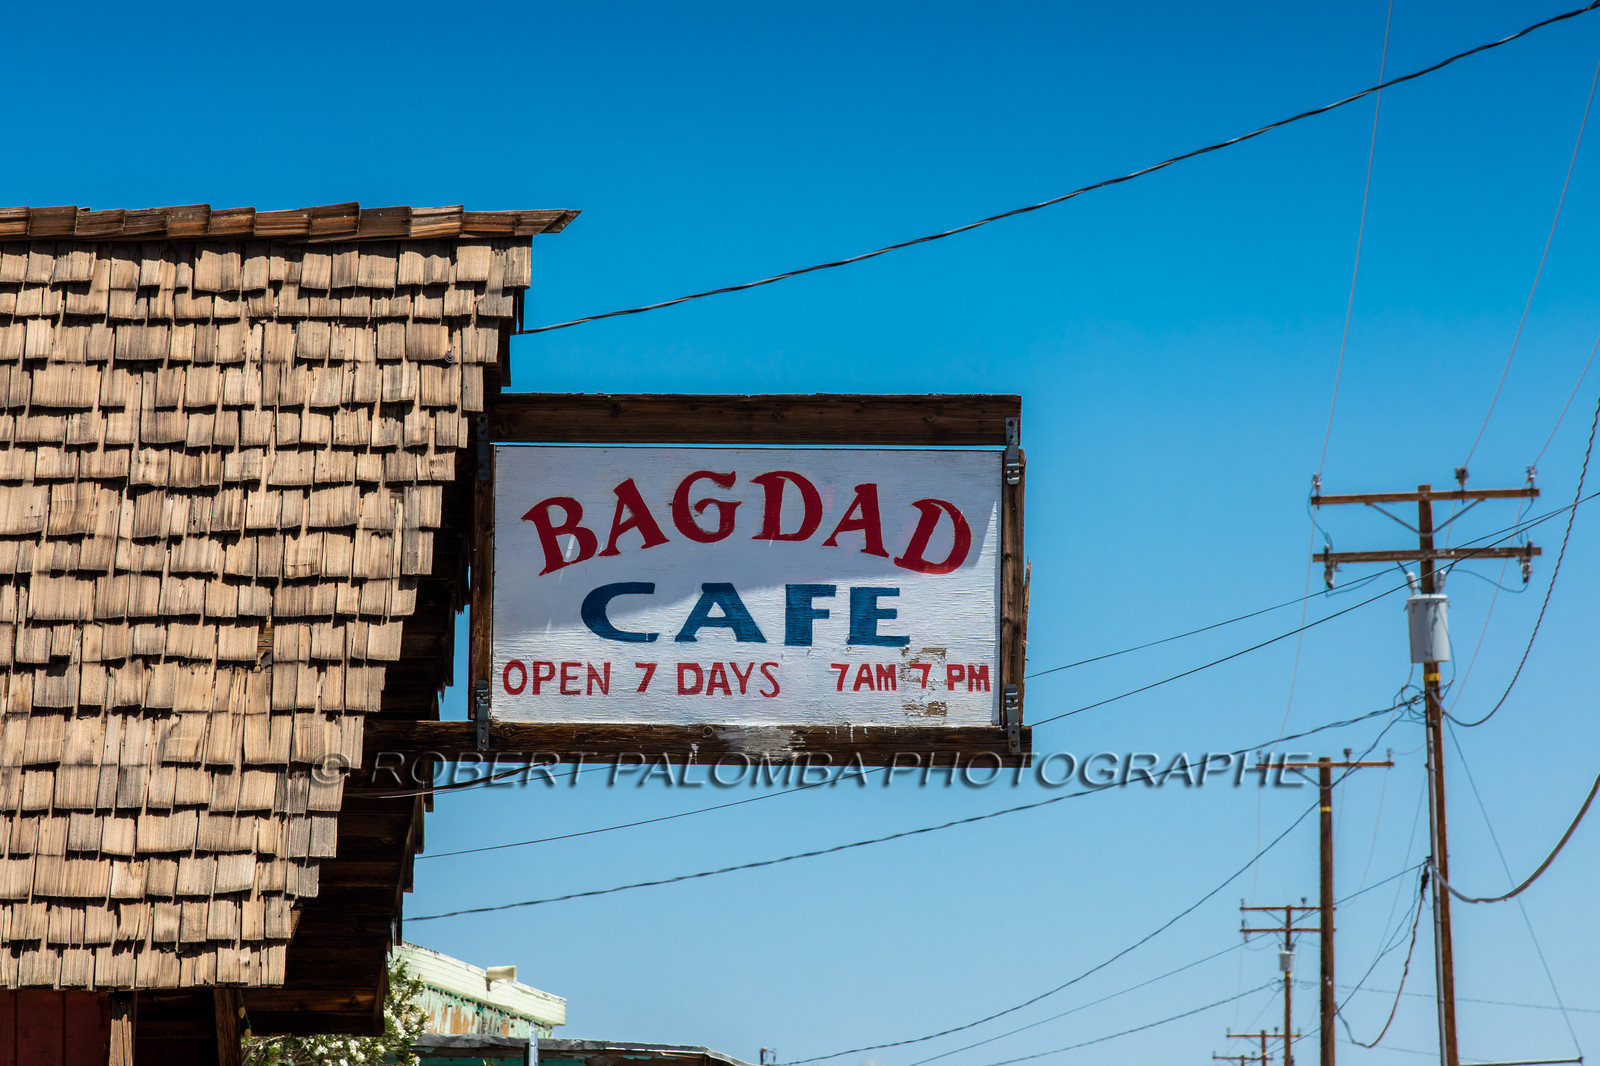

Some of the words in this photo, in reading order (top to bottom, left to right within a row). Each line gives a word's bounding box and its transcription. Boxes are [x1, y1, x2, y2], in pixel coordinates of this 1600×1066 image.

[522, 471, 971, 576] BAGDAD
[580, 582, 911, 647] CAFE
[502, 659, 611, 696] OPEN
[635, 662, 658, 693] 7
[676, 662, 781, 698] DAYS
[910, 663, 933, 690] 7
[946, 663, 991, 693] PM
